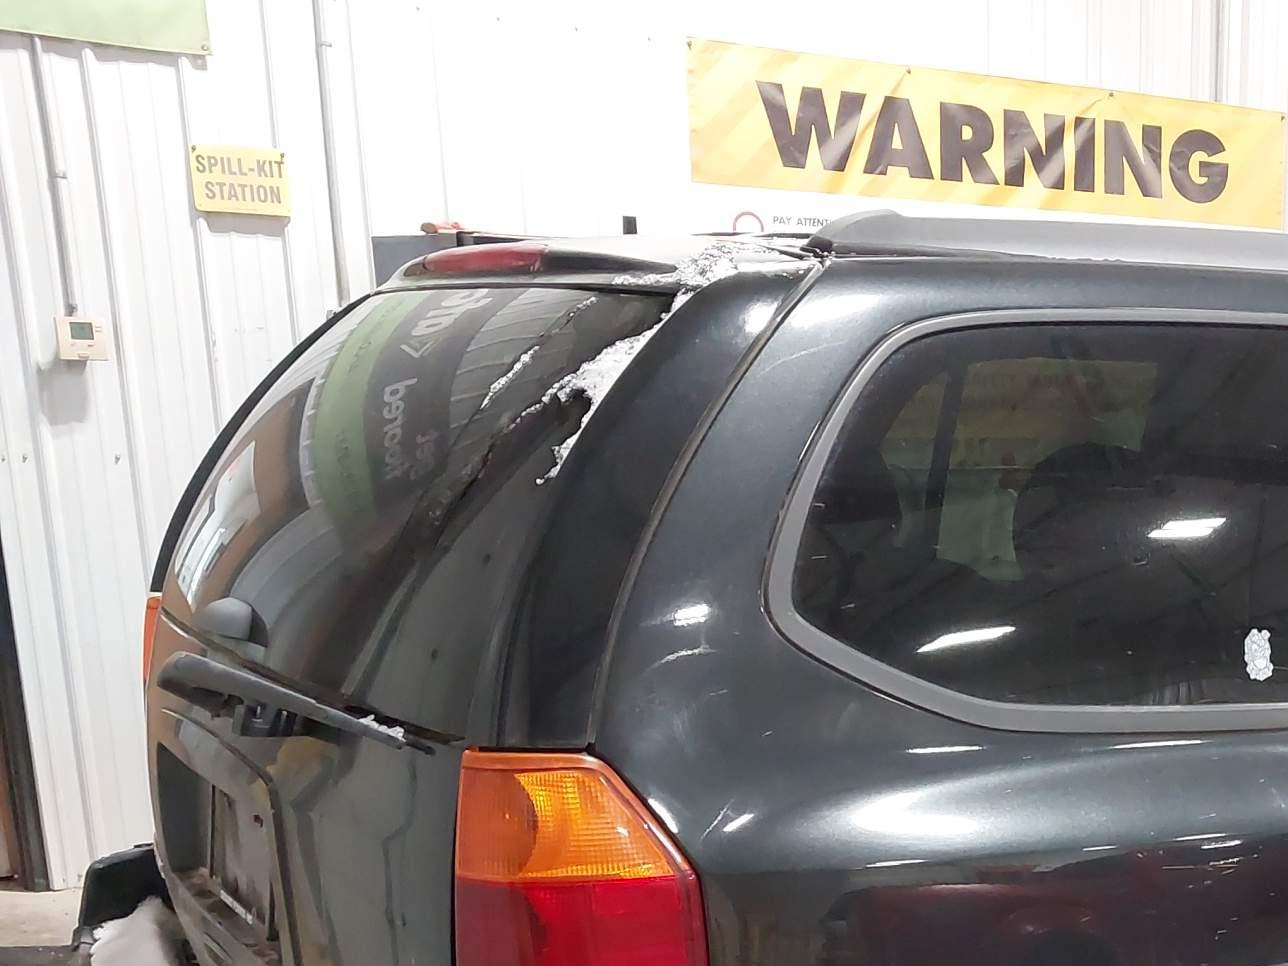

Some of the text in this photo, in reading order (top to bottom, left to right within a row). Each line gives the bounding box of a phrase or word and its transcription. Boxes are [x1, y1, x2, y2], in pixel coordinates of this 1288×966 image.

[755, 80, 1230, 204] WARNING
[194, 153, 285, 179] SPILL-KIT
[204, 180, 282, 205] STATION
[772, 215, 793, 226] PAY
